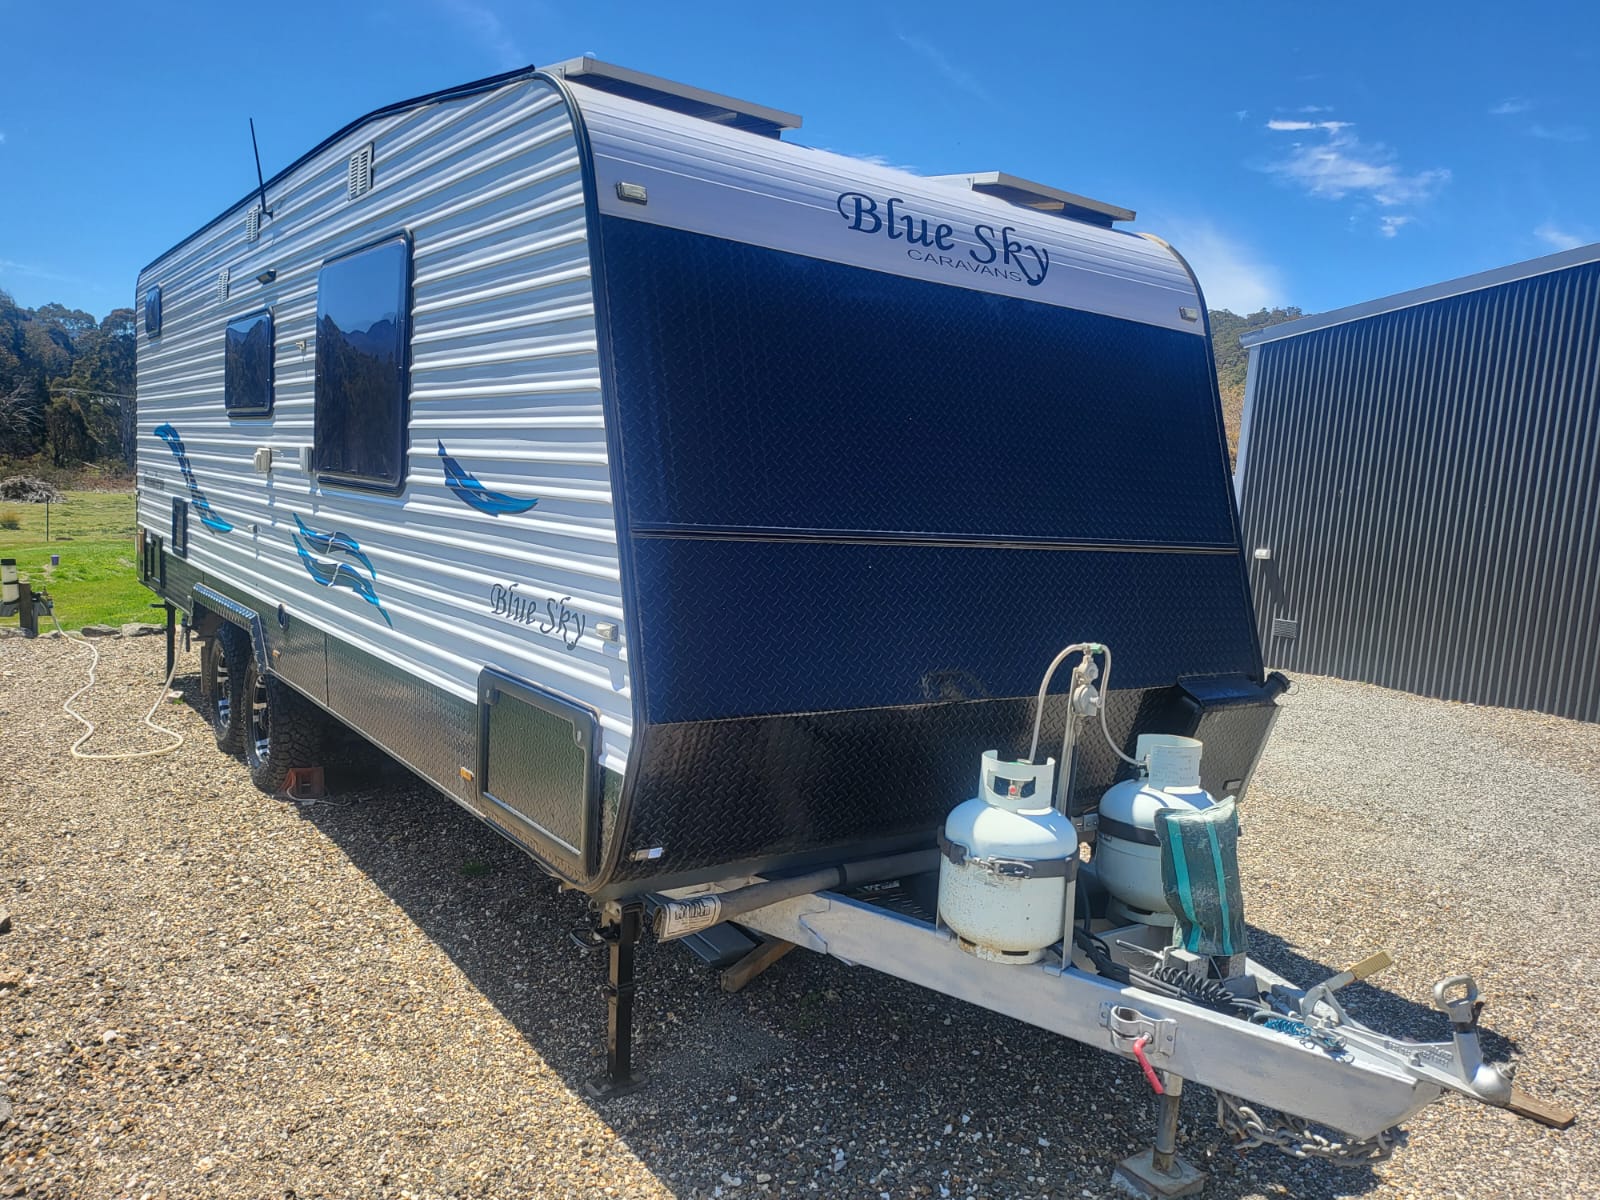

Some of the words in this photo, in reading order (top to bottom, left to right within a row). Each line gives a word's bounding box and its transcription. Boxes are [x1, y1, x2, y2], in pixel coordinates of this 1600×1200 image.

[837, 192, 954, 251] Blue
[970, 224, 1049, 286] Sky
[907, 249, 1022, 282] CARAVANS
[490, 583, 536, 625] Blue
[539, 597, 586, 651] Sky
